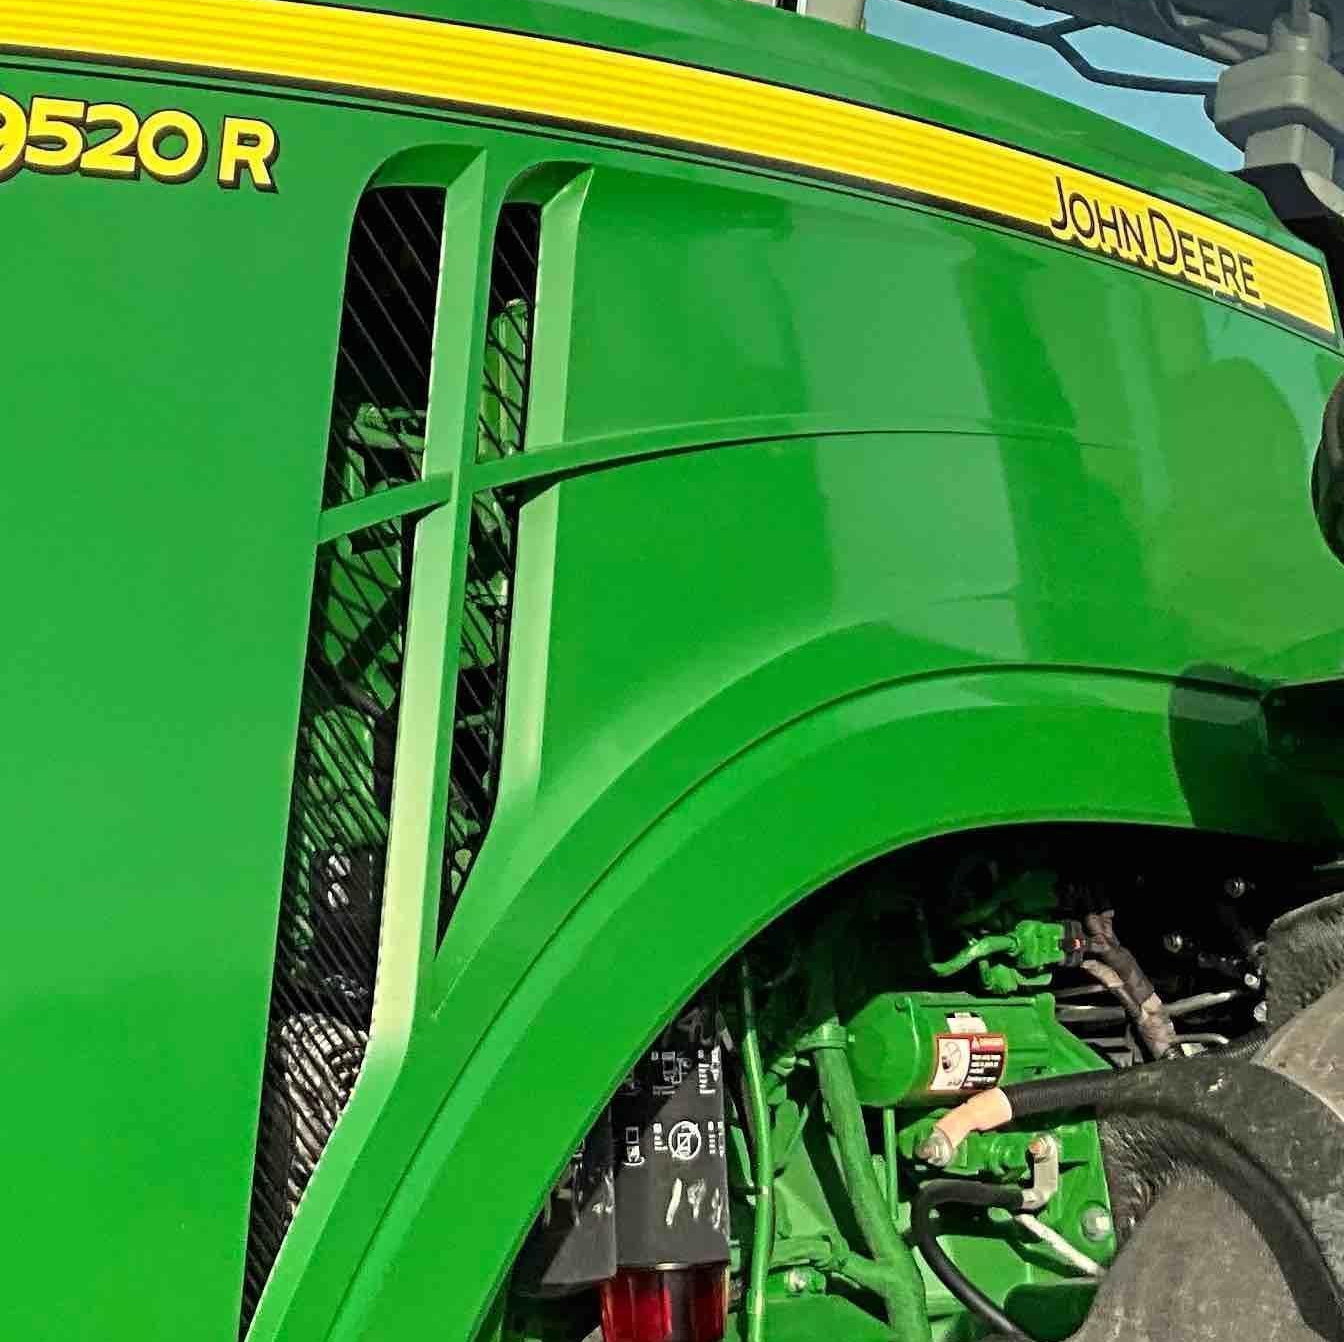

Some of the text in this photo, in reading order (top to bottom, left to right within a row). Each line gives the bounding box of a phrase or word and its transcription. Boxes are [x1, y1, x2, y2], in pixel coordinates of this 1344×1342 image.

[217, 115, 279, 193] R
[1050, 176, 1261, 300] JOHN DEERE
